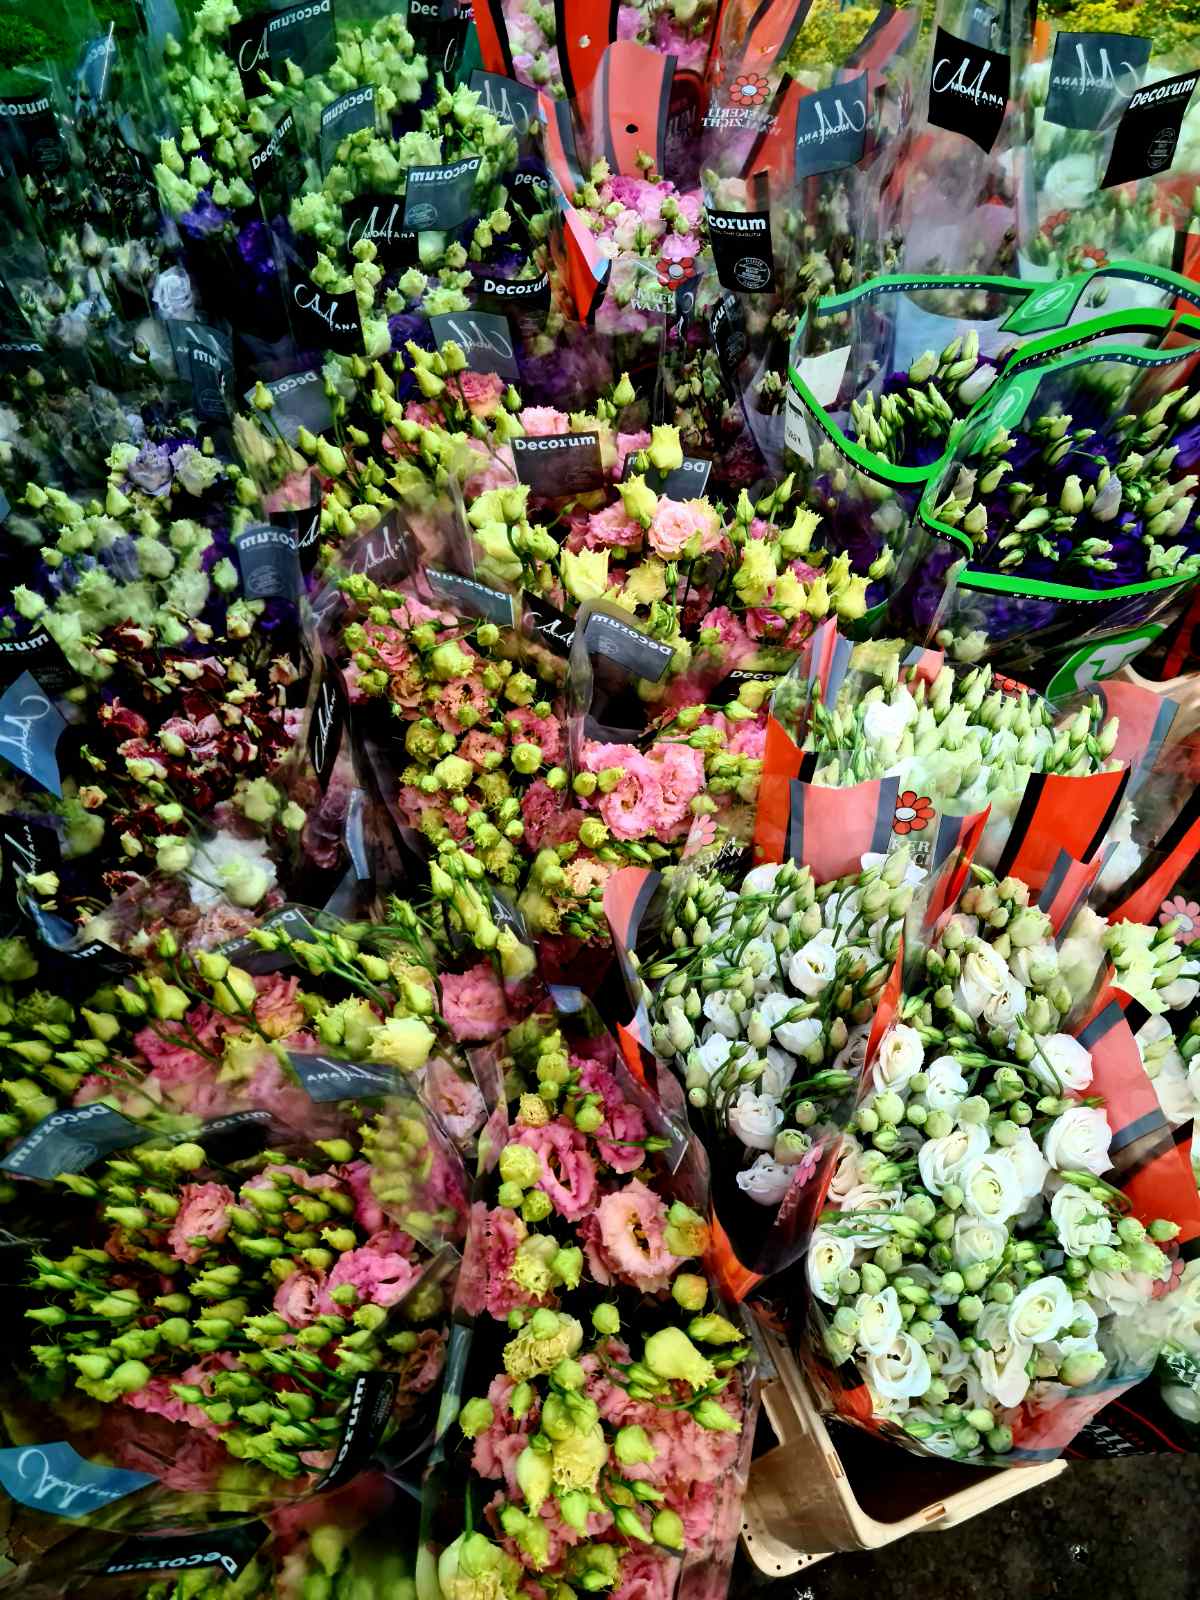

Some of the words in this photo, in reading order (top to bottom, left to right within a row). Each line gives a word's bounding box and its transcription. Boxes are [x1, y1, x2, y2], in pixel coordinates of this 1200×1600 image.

[1129, 78, 1196, 110] Decorum
[0, 97, 49, 117] corum
[515, 173, 548, 189] Deco
[708, 213, 766, 230] corum
[514, 435, 597, 452] Decorum
[730, 670, 775, 681] Deco
